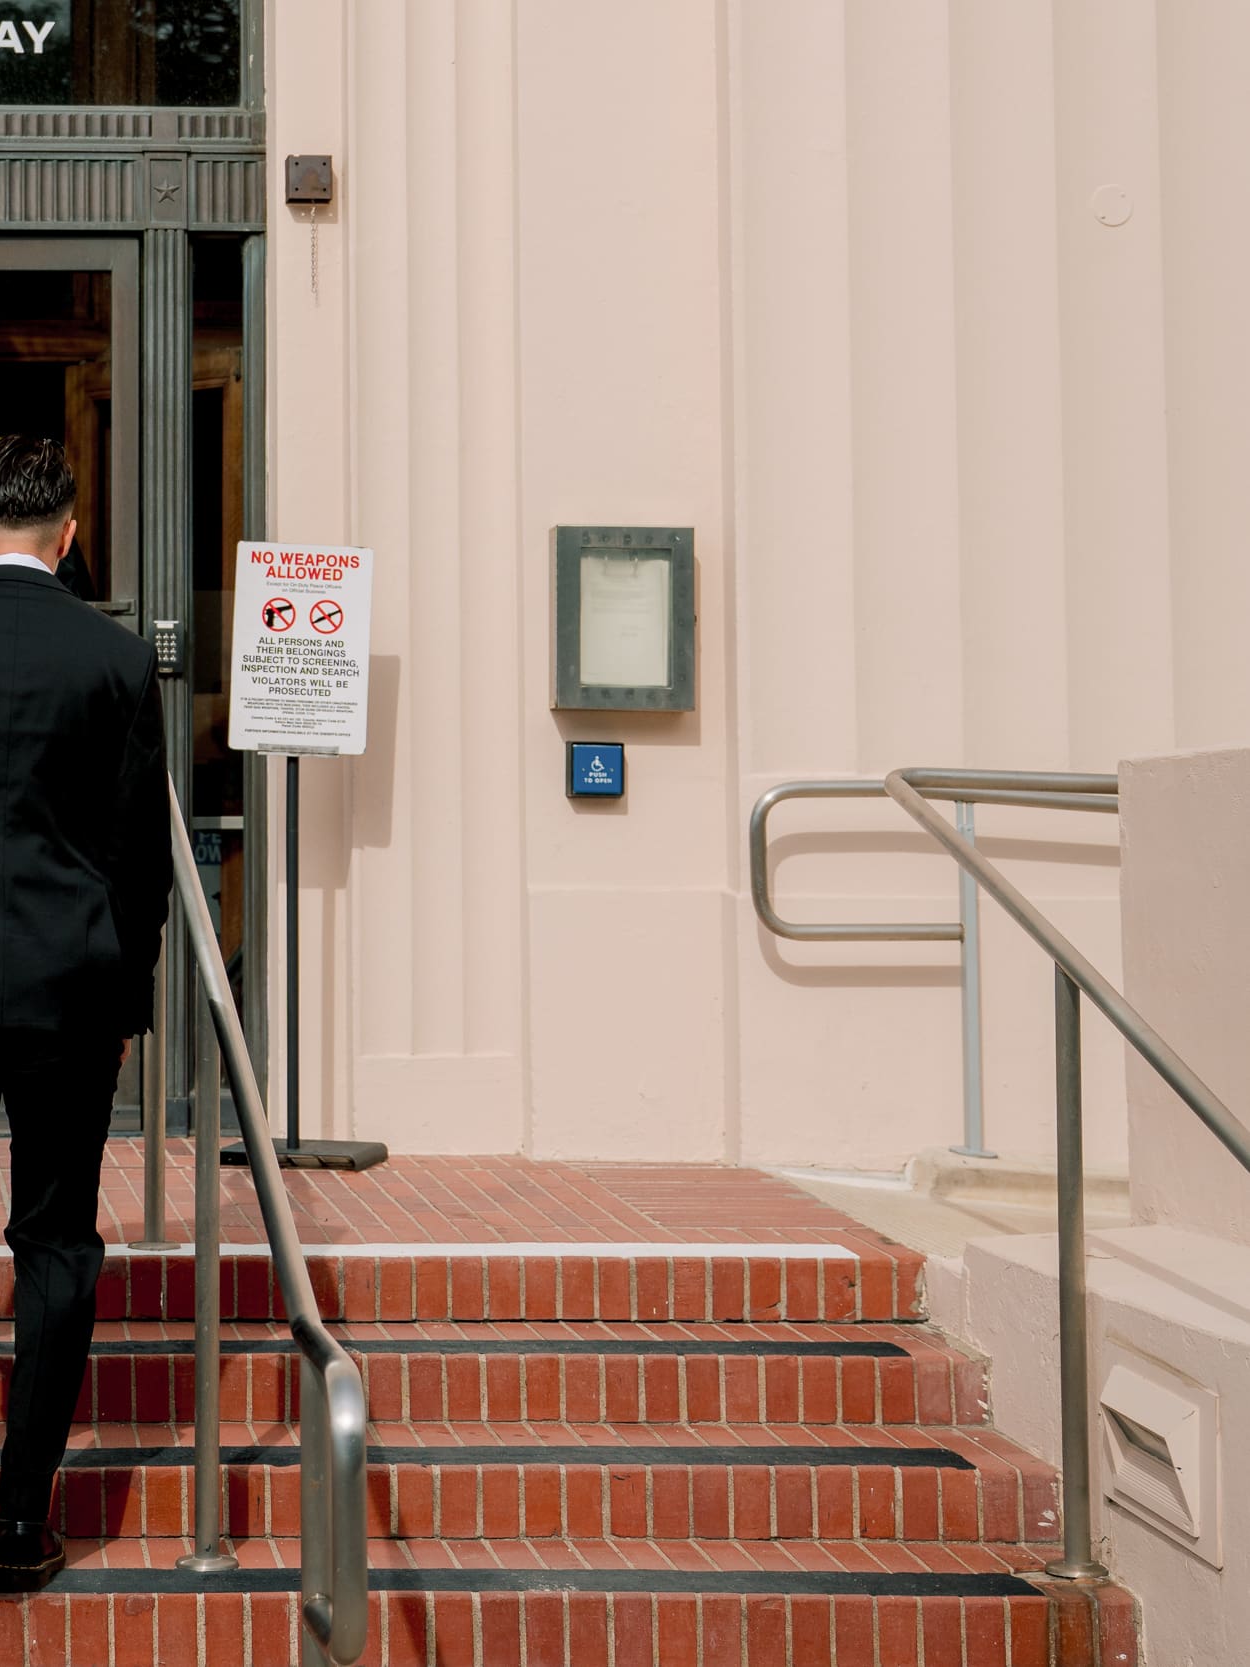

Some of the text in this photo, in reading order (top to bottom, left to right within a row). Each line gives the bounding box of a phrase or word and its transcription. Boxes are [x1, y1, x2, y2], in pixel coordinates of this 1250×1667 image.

[251, 550, 360, 569] NO WEAPONS
[266, 565, 343, 581] ALLOWED
[258, 636, 344, 648] ALL PERSONS AND
[256, 646, 346, 658] THEIR BELONGINGS
[242, 654, 359, 669] SUBJECT TO SCREENING,
[241, 664, 360, 677] INSPECTION AND SEARCH
[251, 676, 349, 689] VIOLATORS WILL BE
[268, 686, 331, 697] PROSECUTED
